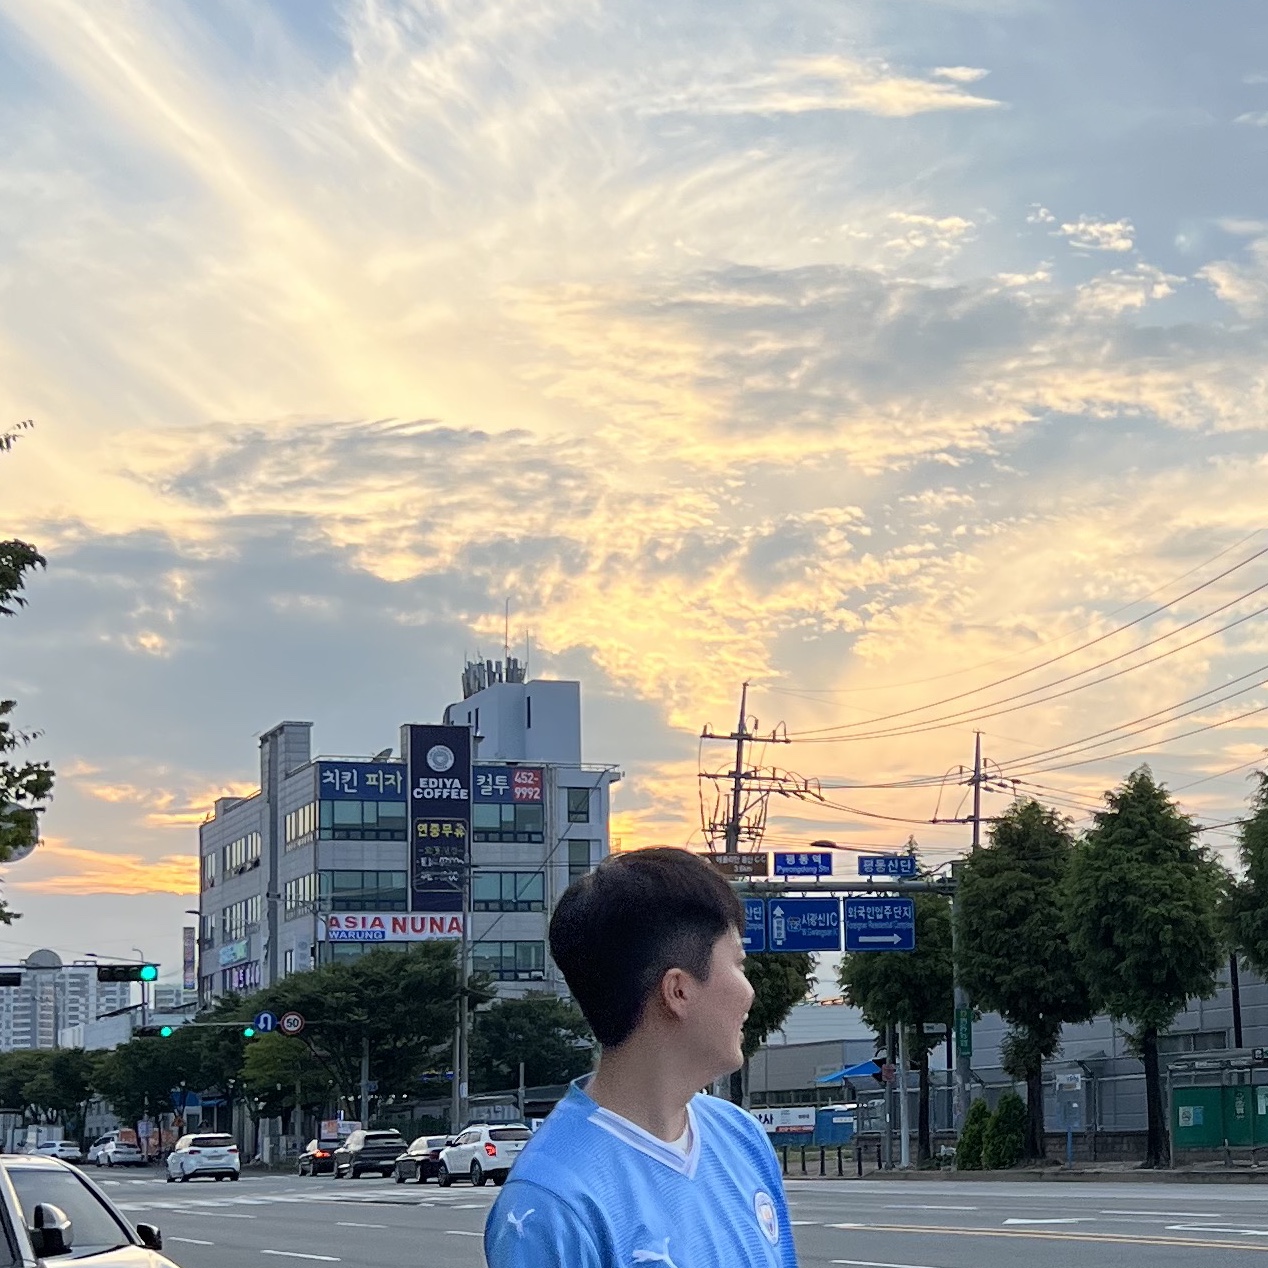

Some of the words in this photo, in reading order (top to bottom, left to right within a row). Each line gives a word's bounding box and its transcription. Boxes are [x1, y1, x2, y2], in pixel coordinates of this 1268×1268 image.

[322, 768, 358, 793] 치킨
[365, 769, 403, 794] 피자
[419, 777, 462, 789] EDIYA
[514, 771, 539, 784] 452-
[476, 773, 510, 796] 컬투
[413, 788, 469, 799] COFFEE
[514, 787, 540, 799] 9992
[417, 823, 465, 838] 연중무휴
[785, 854, 821, 865] 평동역
[329, 916, 385, 929] ASIA
[391, 916, 463, 934] NUNA
[329, 930, 383, 940] WARUNG
[286, 1018, 299, 1028] 50
